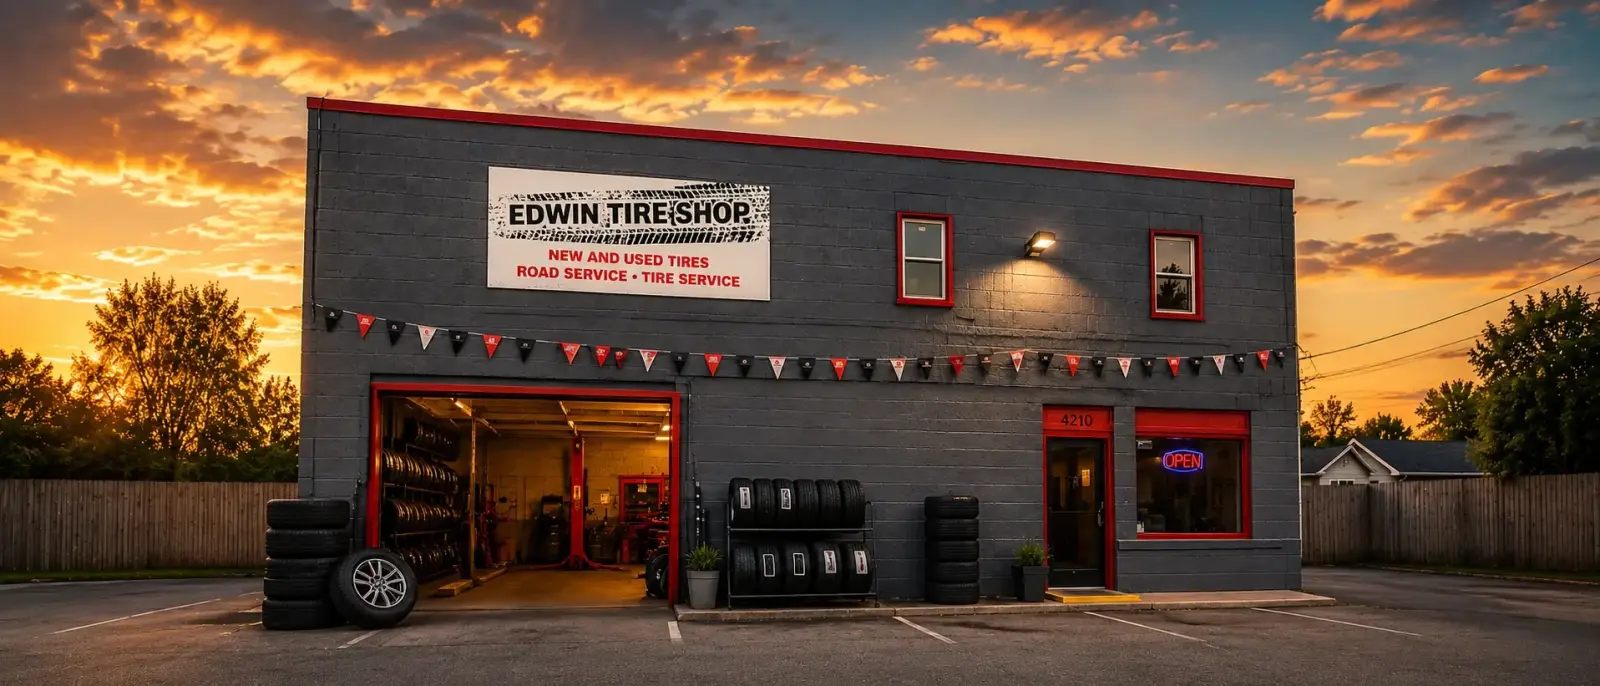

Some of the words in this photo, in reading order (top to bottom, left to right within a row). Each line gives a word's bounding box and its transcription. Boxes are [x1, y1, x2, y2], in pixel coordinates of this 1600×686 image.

[509, 203, 599, 225] EDWIN
[606, 203, 668, 225] TIRE
[674, 202, 749, 225] SHOP
[548, 249, 583, 262] NEW
[587, 251, 620, 264] AND
[624, 253, 663, 266] USED
[668, 255, 709, 268] TIRES
[517, 266, 559, 279] ROAD
[564, 268, 628, 282] SERVICE
[642, 272, 675, 284] TIRE
[678, 273, 740, 287] SERVICE
[1061, 414, 1092, 427] 4210
[1165, 453, 1201, 469] OPEN
